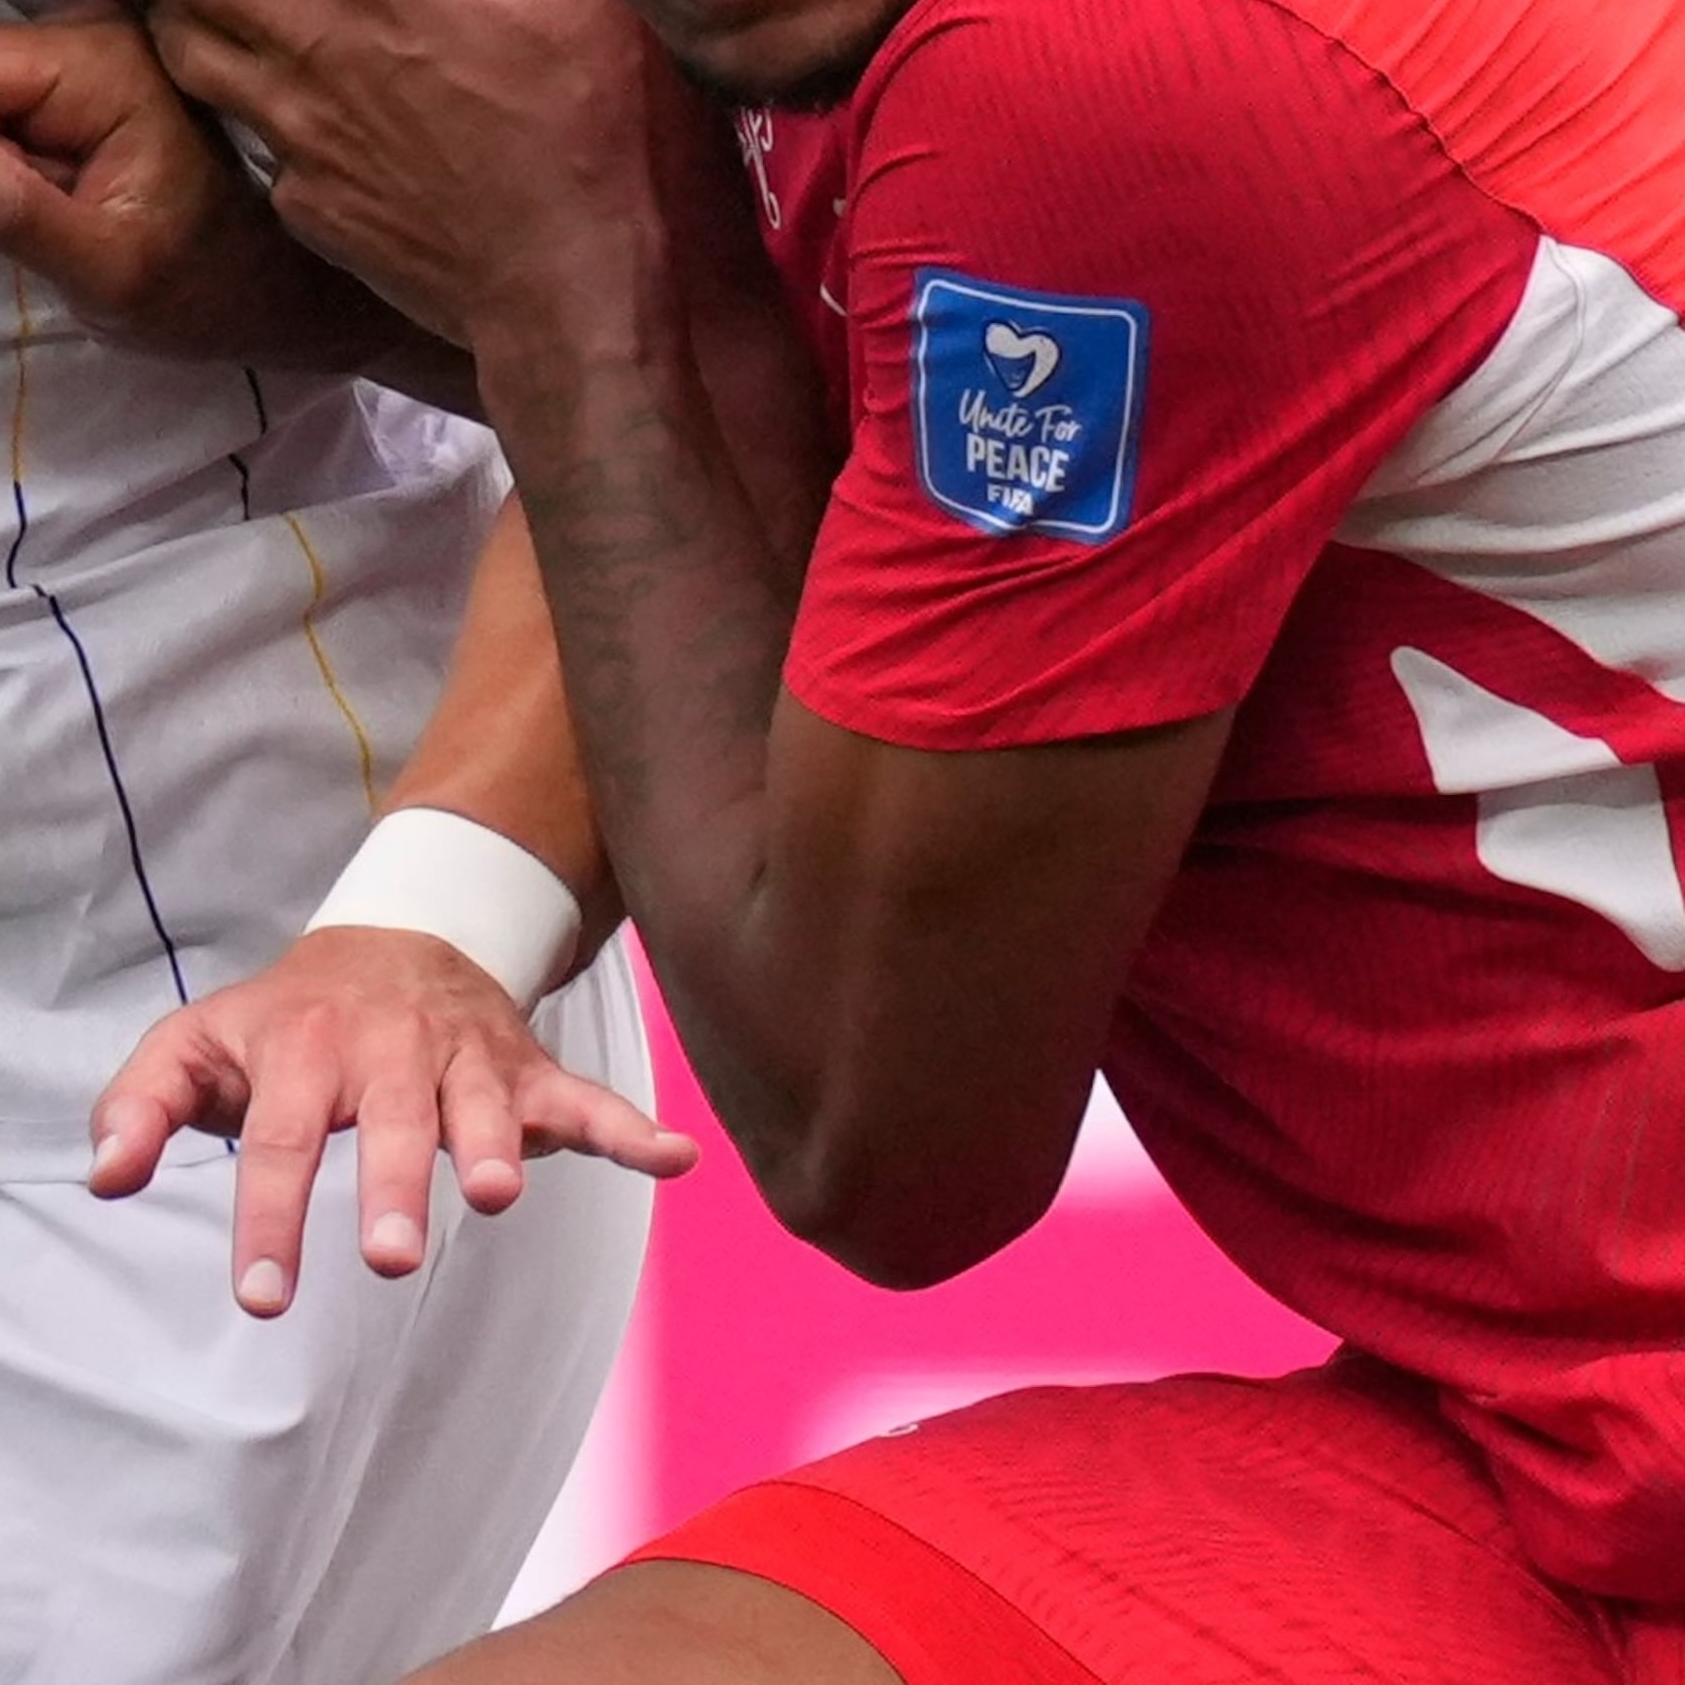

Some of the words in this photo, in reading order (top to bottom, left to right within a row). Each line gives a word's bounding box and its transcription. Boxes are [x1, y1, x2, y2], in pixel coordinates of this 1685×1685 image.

[958, 388, 1033, 438] Unite
[1035, 404, 1082, 444] For
[966, 432, 1070, 492] PEACE
[987, 482, 1034, 515] FIFA
